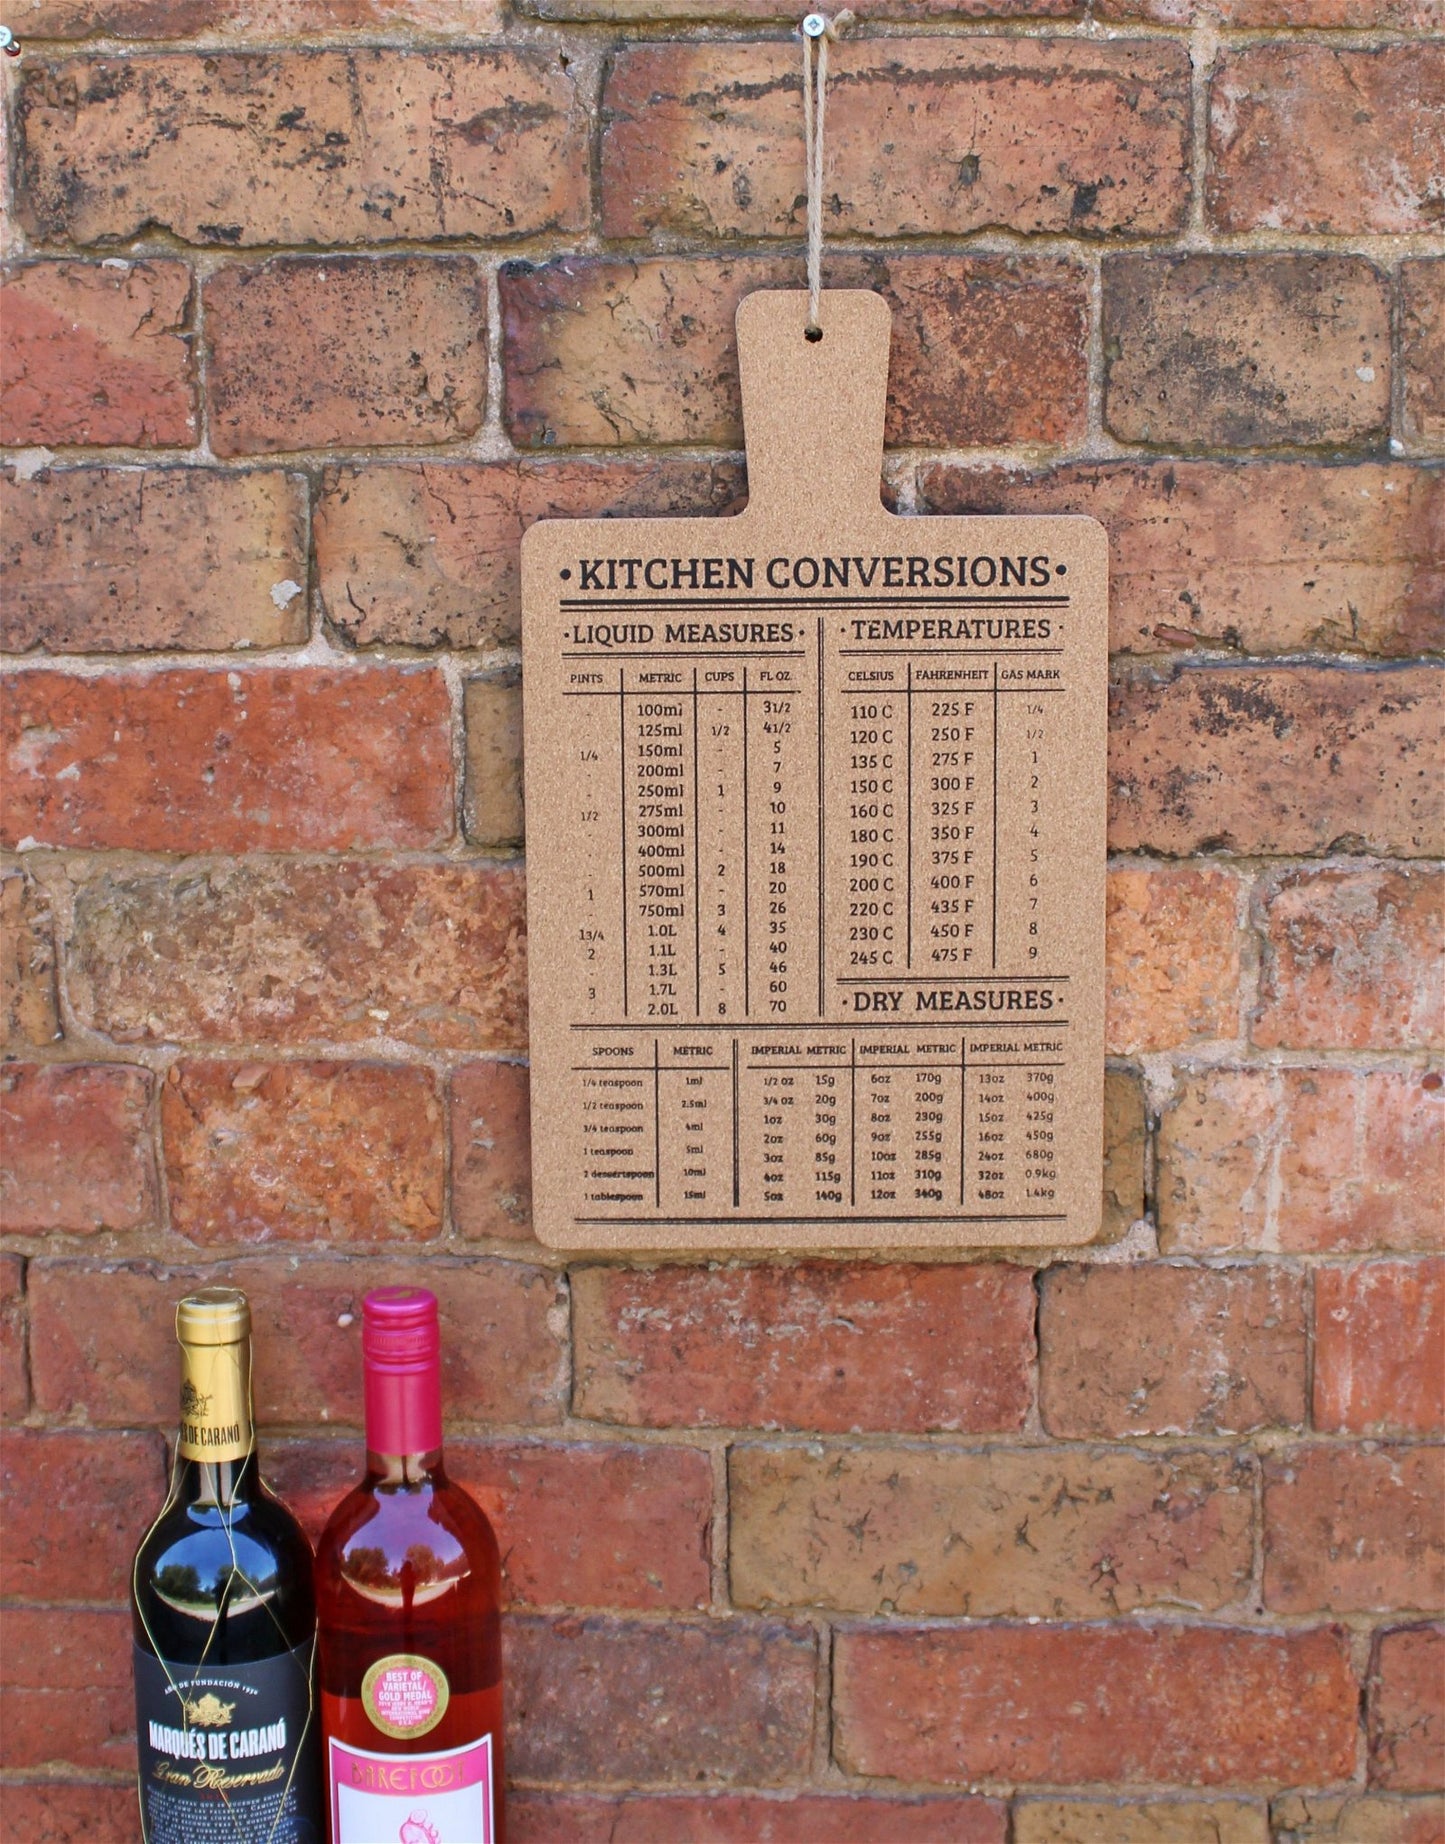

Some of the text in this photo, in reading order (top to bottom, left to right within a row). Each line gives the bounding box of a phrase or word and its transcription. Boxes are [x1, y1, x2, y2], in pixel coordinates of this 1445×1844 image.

[579, 556, 1050, 590] KITCHEN CONVERSIONS
[573, 623, 793, 647] LIQUID MEASURES
[851, 619, 1050, 640] TEMPERATURES
[570, 673, 604, 684] PINTS
[638, 672, 683, 684] METRIC
[704, 671, 735, 683] CUPS
[759, 670, 774, 682] FL
[847, 670, 895, 682] CELSIUS
[915, 669, 989, 681] FAHRENHEIT
[1000, 669, 1061, 680] GAS MARK
[637, 702, 683, 717] 100ml
[850, 704, 878, 720] 110
[931, 701, 960, 717] 225
[638, 723, 683, 737] 125ml
[711, 724, 730, 737] 1/2
[850, 729, 879, 745] 120
[931, 726, 961, 742] 250
[580, 749, 599, 762] 1/4
[637, 743, 683, 758] 150ml
[850, 754, 878, 770] 135
[932, 751, 959, 767] 275
[637, 762, 684, 778] 200ml
[637, 783, 684, 798] 250ml
[850, 778, 879, 795] 150
[930, 776, 961, 792] 300
[638, 803, 684, 818] 275ml
[769, 800, 787, 815] 10
[850, 804, 879, 819] 160
[931, 800, 960, 816] 325
[581, 810, 599, 822] 1/2
[637, 823, 685, 838] 300ml
[770, 821, 785, 835] 11
[930, 824, 961, 841] 350
[850, 828, 879, 844] 180
[637, 843, 685, 858] 400ml
[769, 841, 786, 855] 14
[850, 852, 879, 869] 190
[931, 850, 959, 865] 375
[638, 863, 685, 878] 500ml
[769, 861, 787, 875] 18
[768, 881, 787, 895] 20
[849, 877, 879, 893] 200
[930, 874, 961, 890] 400
[639, 883, 685, 898] 570ml
[638, 902, 685, 918] 750ml
[769, 901, 787, 915] 26
[849, 902, 879, 917] 220
[930, 898, 960, 914] 435
[648, 923, 678, 937] 1.0L
[769, 920, 787, 935] 35
[849, 926, 879, 942] 230
[930, 923, 960, 938] 450
[649, 943, 677, 957] 1.1L
[769, 940, 788, 955] 40
[931, 947, 958, 962] 475
[850, 950, 878, 966] 245
[648, 962, 678, 977] 1.3L
[769, 960, 788, 974] 46
[649, 982, 677, 996] 1.7L
[769, 980, 788, 994] 60
[769, 999, 787, 1013] 70
[854, 990, 1053, 1011] DRY MEASURES
[647, 1002, 679, 1016] 2.0L
[592, 1046, 635, 1057] SPOONS
[673, 1045, 713, 1056] METRIC
[750, 1045, 803, 1056] IMPERIAL
[806, 1045, 847, 1056] METRIC
[859, 1044, 910, 1055] IMPERIAL
[916, 1043, 956, 1054] METRIC
[969, 1043, 1020, 1053] IMPERIAL
[1023, 1041, 1063, 1052] METRIC
[188, 1424, 199, 1446] DE
[386, 1671, 423, 1682] BEST OF
[379, 1690, 432, 1701] GOLD MEDAL
[149, 1717, 287, 1760] MARQUÉS DE CARANÓ
[152, 1761, 192, 1786] Gran
[351, 1760, 465, 1790] BAREFOOT
